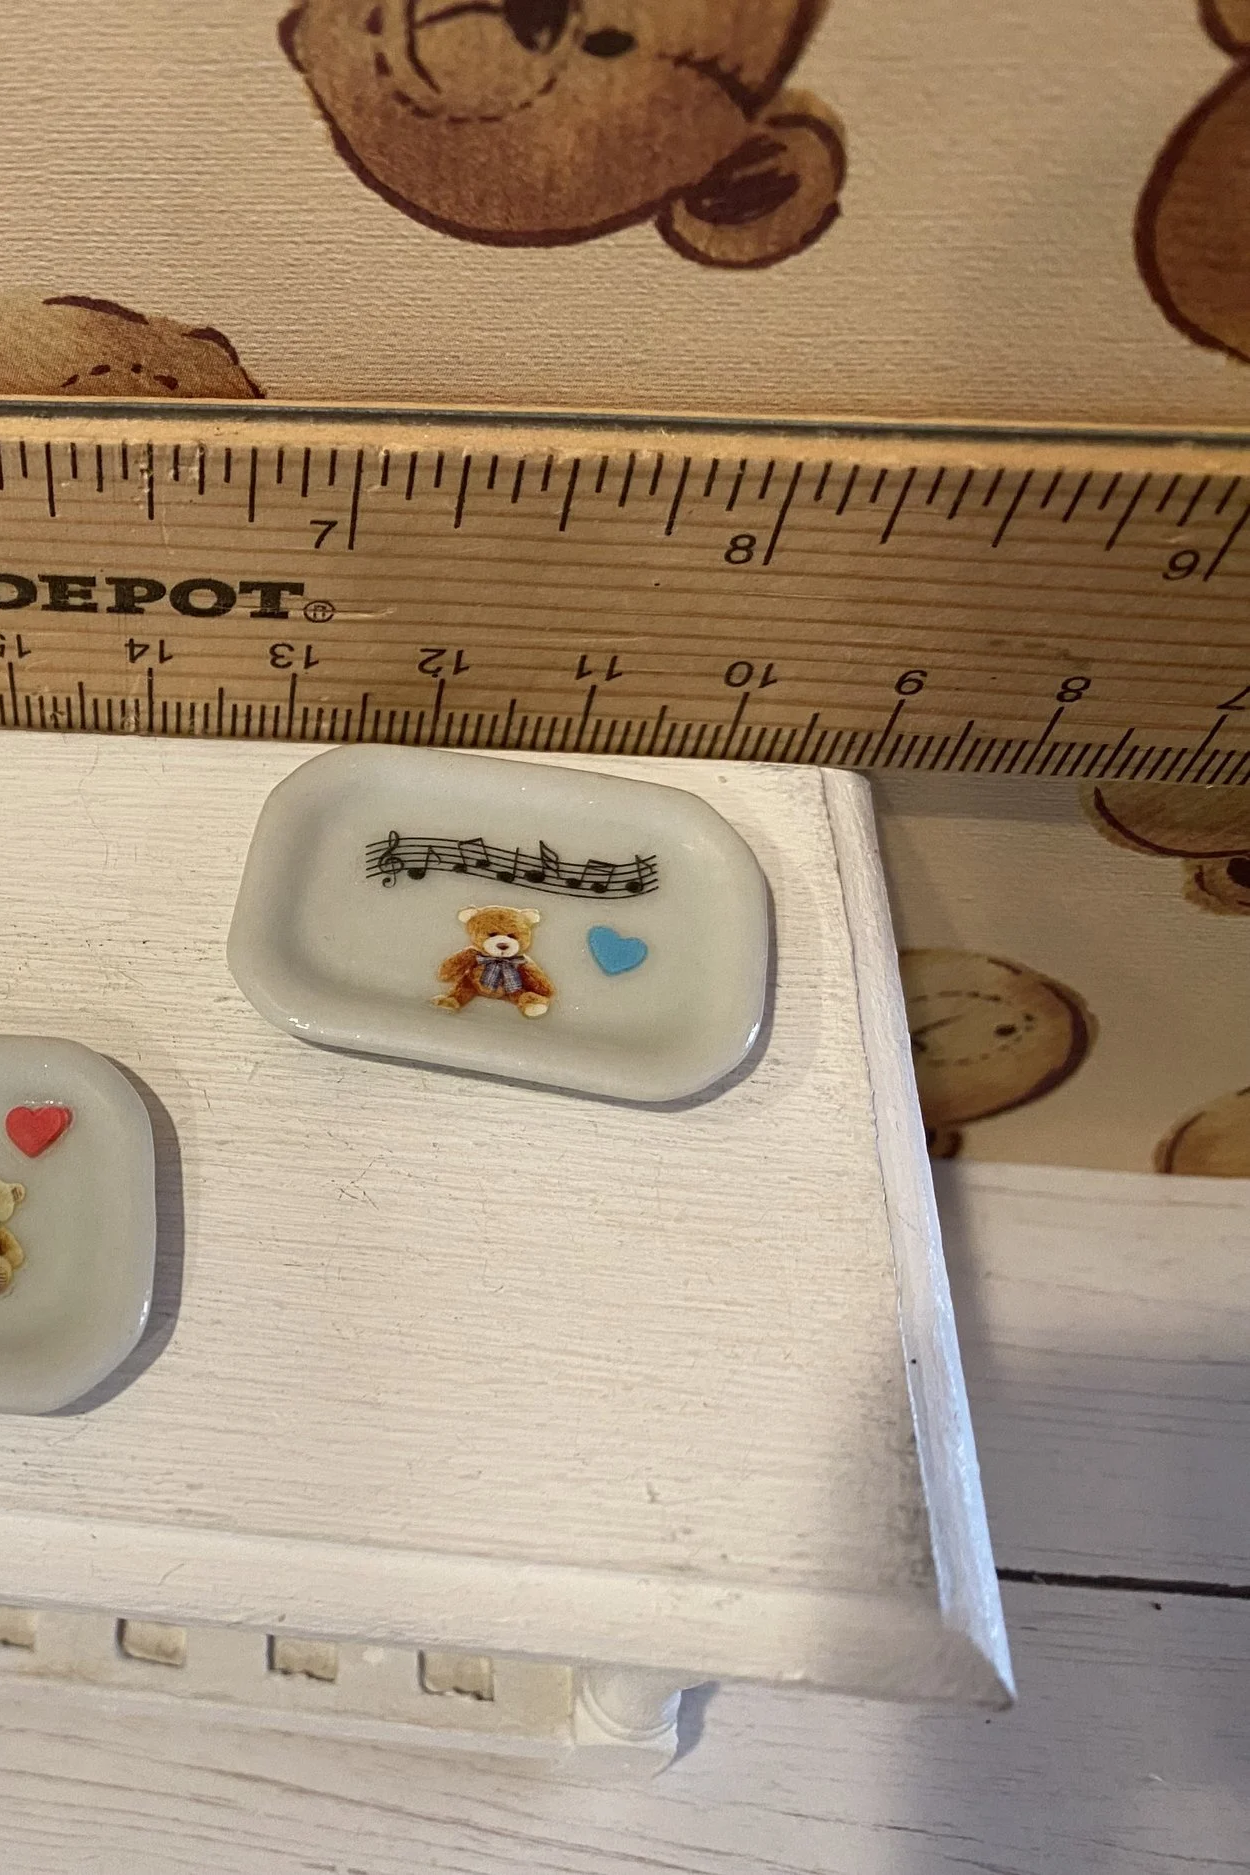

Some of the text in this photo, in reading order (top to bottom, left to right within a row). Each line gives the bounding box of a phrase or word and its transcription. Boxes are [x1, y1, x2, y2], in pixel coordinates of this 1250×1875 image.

[309, 519, 339, 549] 7
[724, 534, 757, 564] 8
[1162, 549, 1200, 580] 9
[125, 638, 174, 664] 14
[269, 642, 320, 670] 13
[419, 647, 471, 676] 12
[575, 654, 623, 682] 11
[724, 661, 779, 689] 10
[895, 668, 928, 696] 9
[1057, 676, 1091, 702] 8
